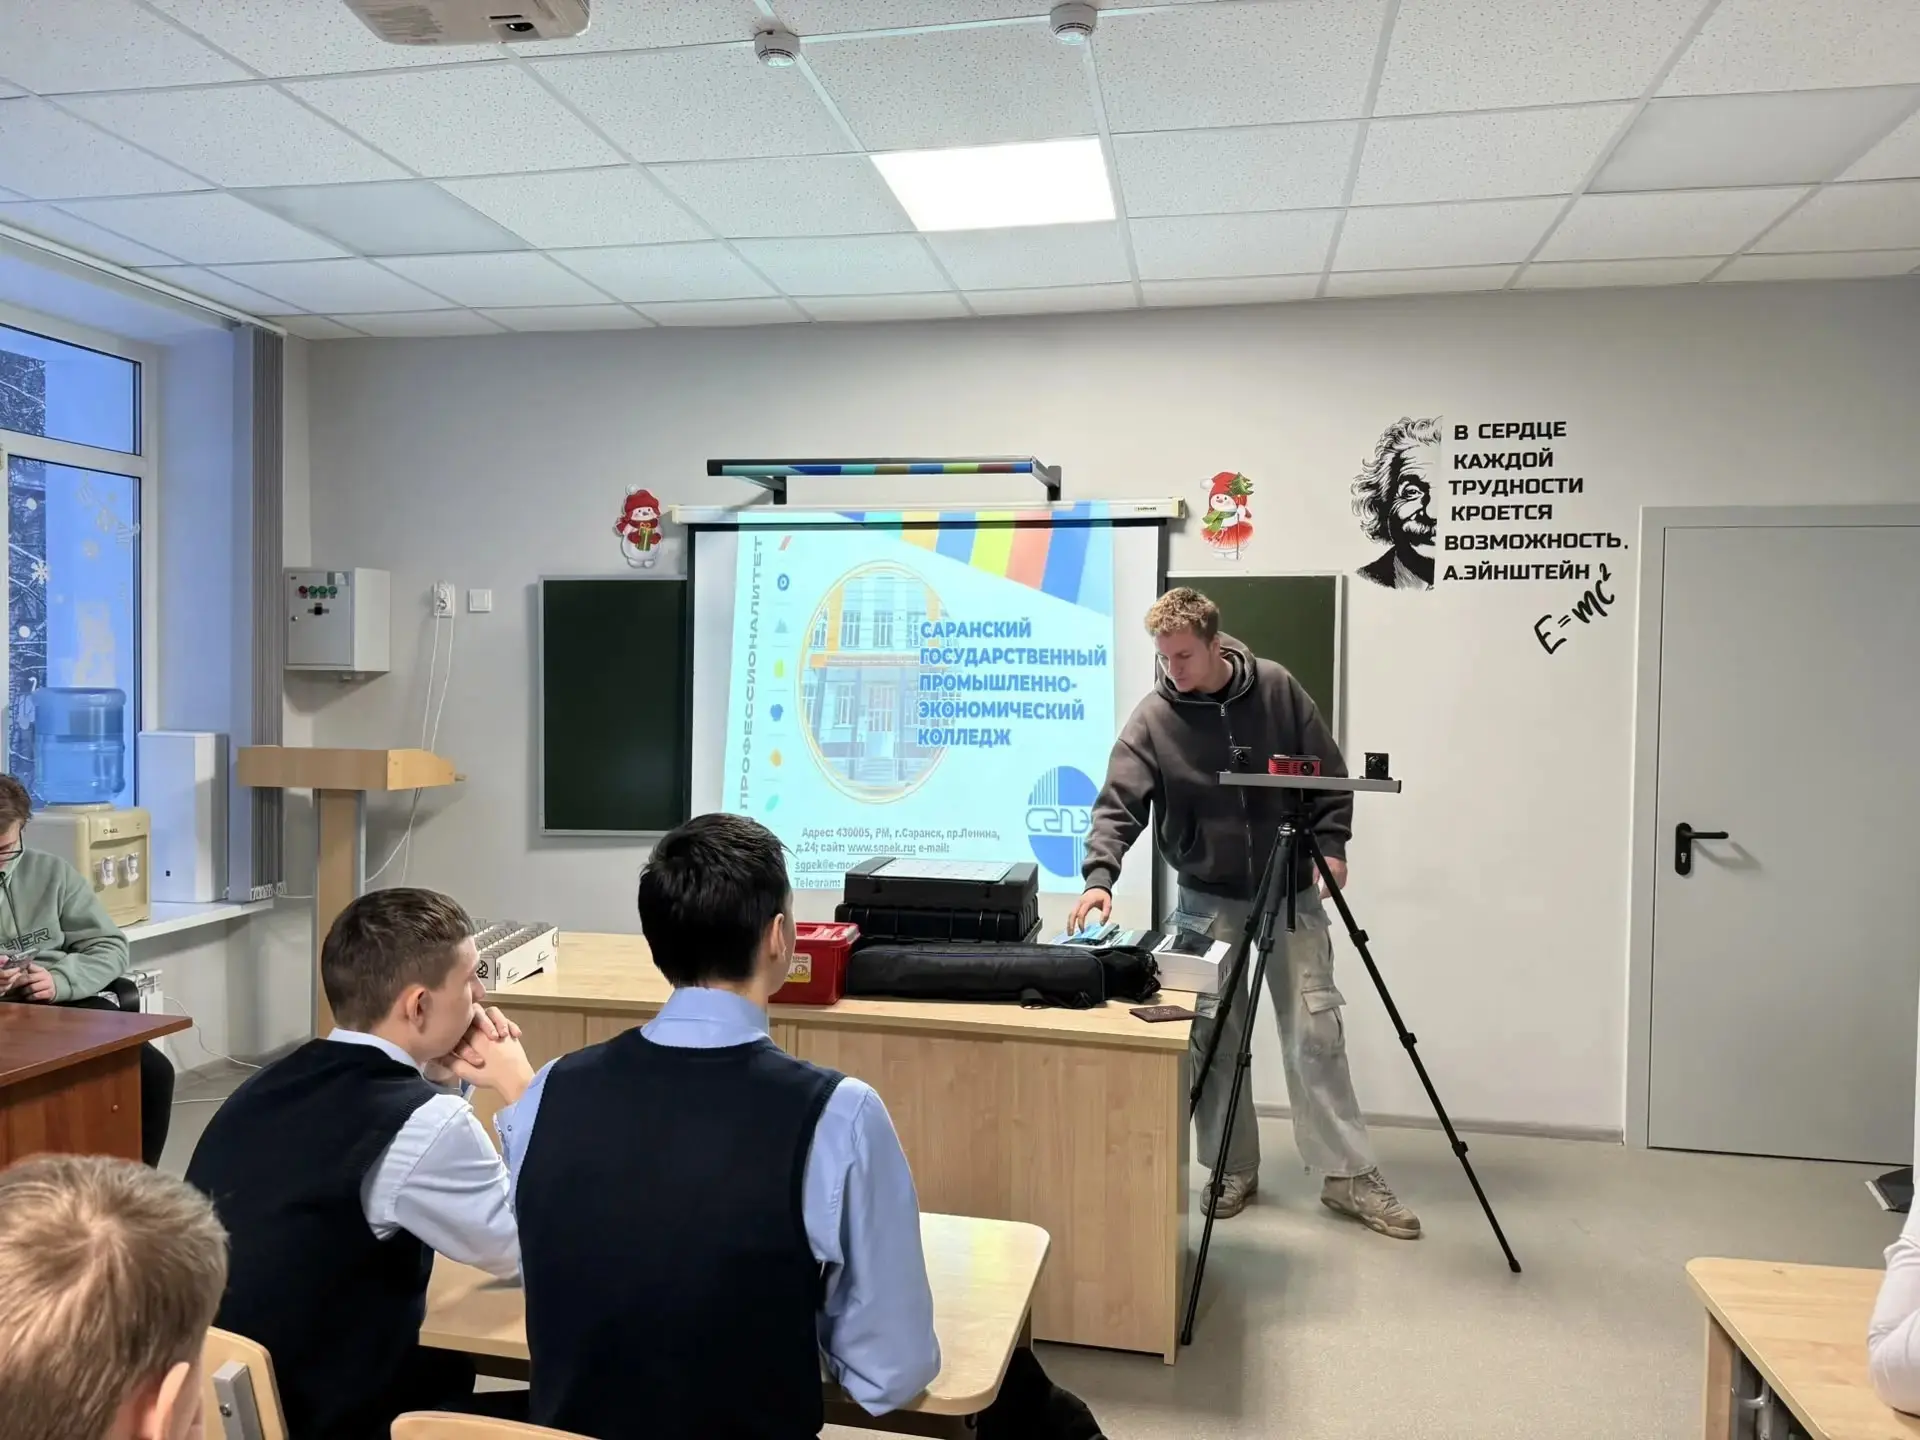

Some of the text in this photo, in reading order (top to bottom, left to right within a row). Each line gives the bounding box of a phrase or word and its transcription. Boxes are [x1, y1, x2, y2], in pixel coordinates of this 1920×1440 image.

[1453, 421, 1567, 440] В СЕРДЦЕ
[1453, 448, 1553, 470] КАЖДОЙ
[1449, 478, 1584, 497] ТРУДНОСТИ
[1451, 505, 1553, 521] КРОЕТСЯ
[1444, 532, 1629, 550] ВОЗМОЖНОСТЬ.
[1443, 561, 1590, 580] А.ЭЙНШТЕЙН
[920, 617, 1032, 638] САРАНСКИЙ
[920, 645, 1107, 667] ГОСУДАРСТВЕННЫЙ
[740, 536, 763, 809] ПРОФЕССИОНАЛИТЕТ
[919, 674, 1077, 692] ПРОМЫШЛЕННО-
[918, 699, 1085, 720] ЭКОНОМИЧЕСКИЙ
[918, 728, 1012, 748] КОЛЛЕДЖ
[801, 827, 834, 840] Адрес:
[836, 828, 873, 840] 430005,
[918, 843, 950, 852] e-mail:
